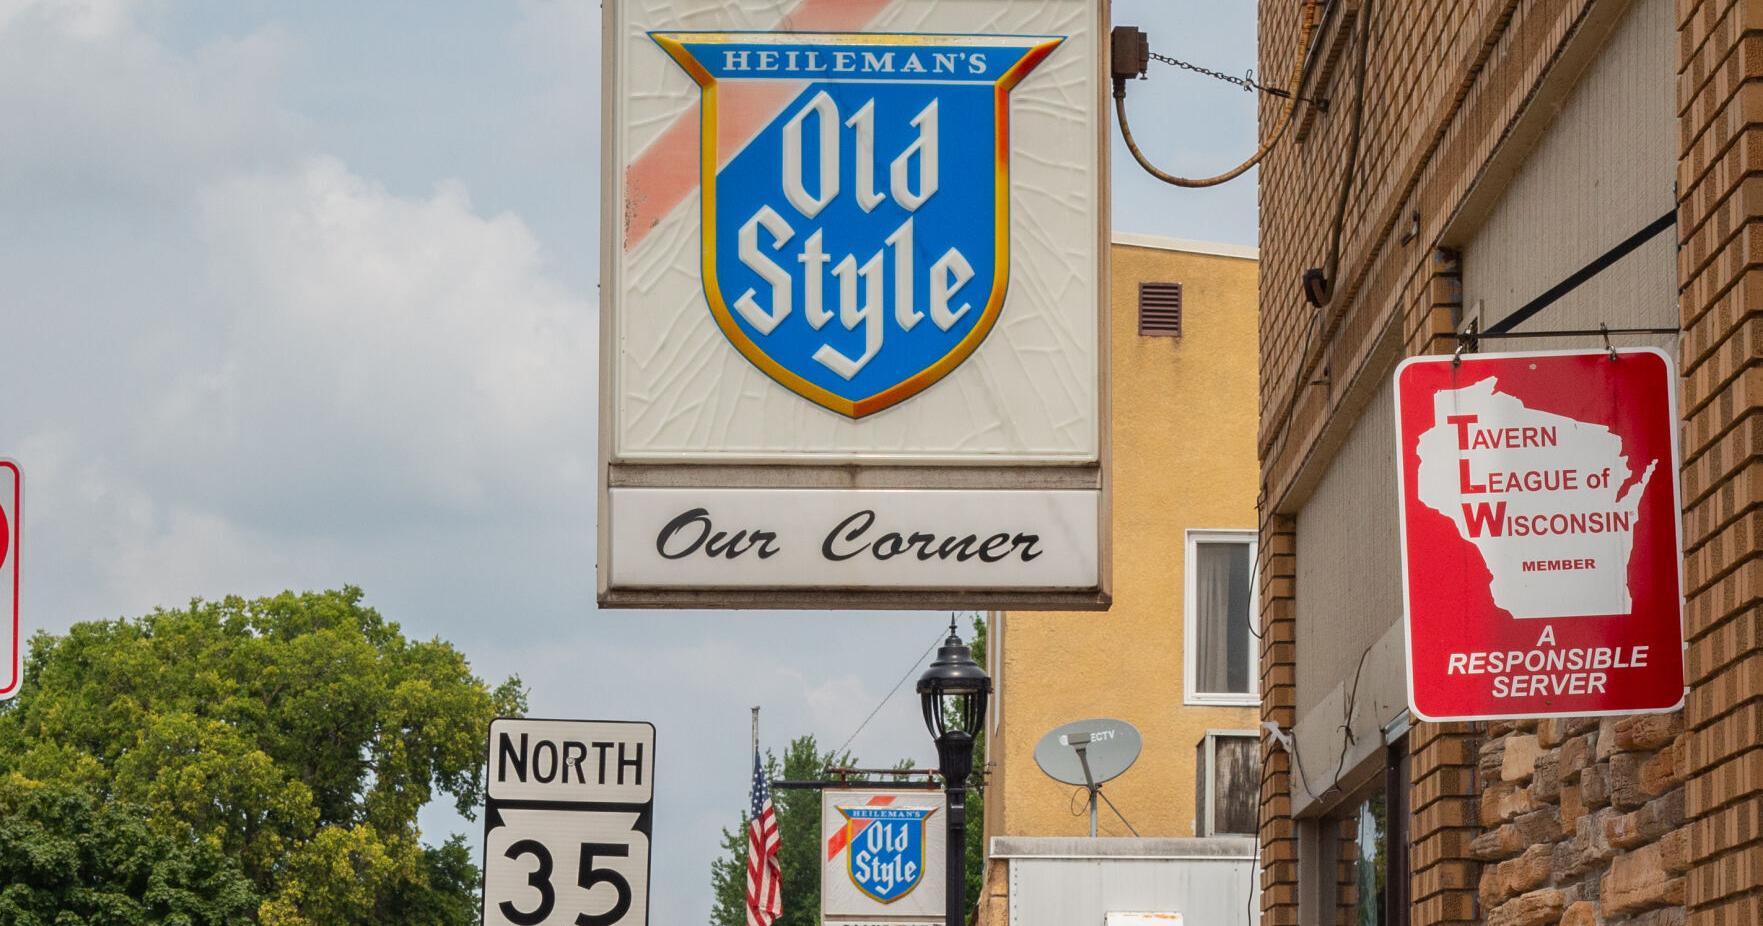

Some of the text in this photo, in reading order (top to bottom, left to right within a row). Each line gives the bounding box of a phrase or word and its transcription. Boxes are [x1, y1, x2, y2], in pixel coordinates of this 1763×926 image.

[722, 50, 988, 74] HEILEMAN'S
[781, 90, 939, 219] Old
[733, 204, 976, 381] Style
[1447, 414, 1557, 450] TAVERN
[1459, 458, 1610, 494] LEAGUE of
[656, 507, 1043, 563] Our Corner
[1522, 558, 1596, 572] MEMBER
[1536, 624, 1556, 647] A
[1447, 646, 1649, 675] RESPONSIBLE
[1491, 672, 1607, 698] SERVER
[498, 732, 643, 785] NORTH
[852, 810, 921, 818] HEILEMAN'S
[867, 820, 908, 855] Old
[498, 839, 632, 926] 35
[855, 849, 917, 895] Style
